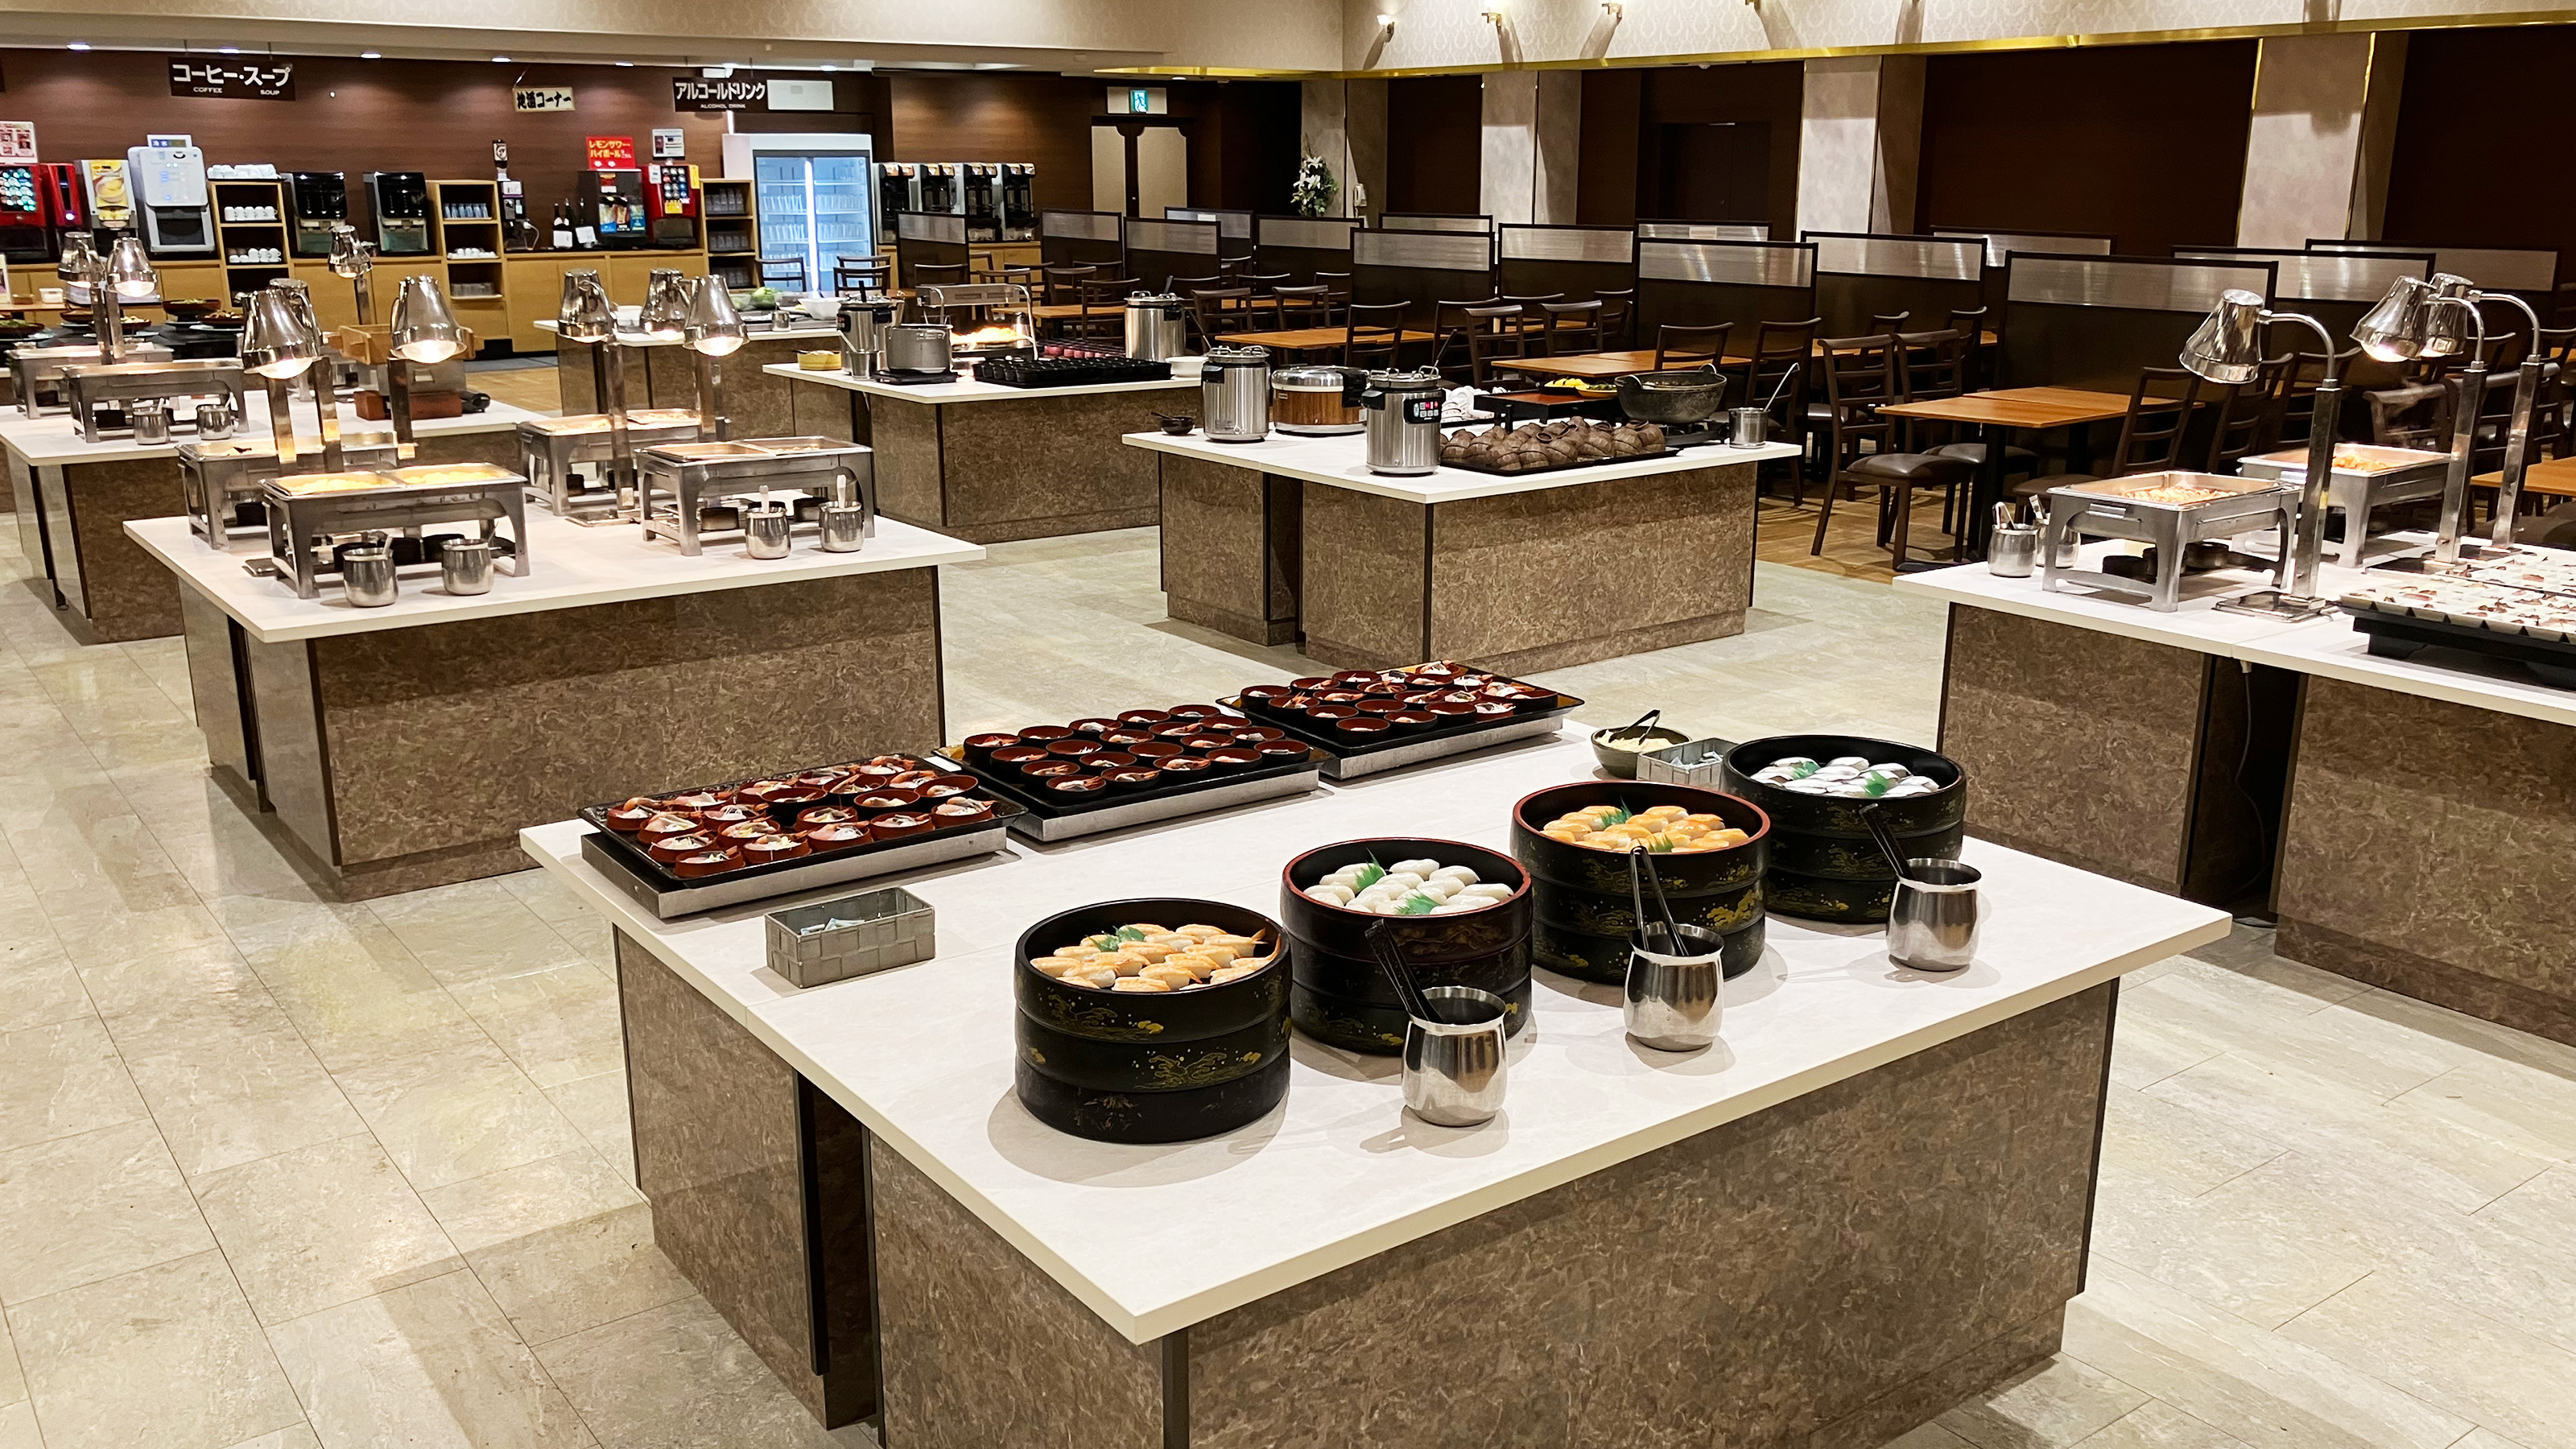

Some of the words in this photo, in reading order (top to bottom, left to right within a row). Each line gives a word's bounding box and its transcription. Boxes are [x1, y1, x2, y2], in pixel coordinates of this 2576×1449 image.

[675, 82, 766, 100] アルコールドリンク
[588, 140, 631, 149] レモンサワー
[590, 149, 621, 158] ハイボール
